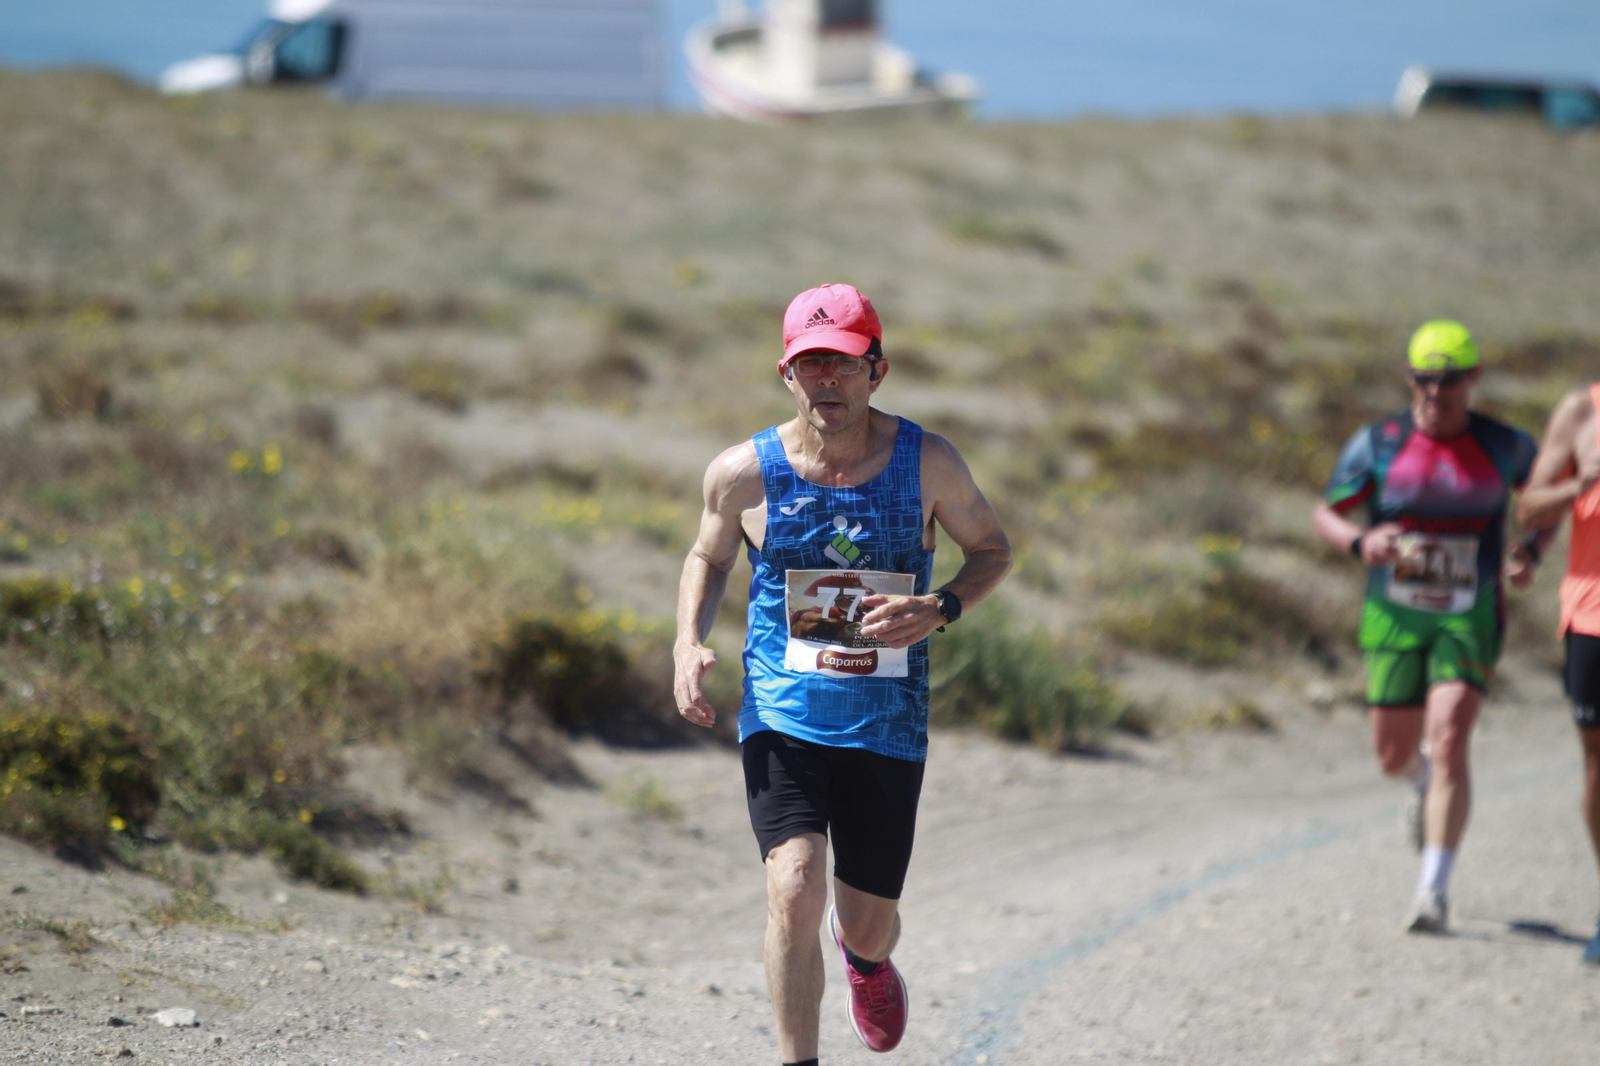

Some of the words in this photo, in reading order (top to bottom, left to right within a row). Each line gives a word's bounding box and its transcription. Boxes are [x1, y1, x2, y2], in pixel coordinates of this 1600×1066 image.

[805, 318, 835, 329] adidas
[852, 554, 872, 570] ISMO
[818, 586, 866, 622] 77
